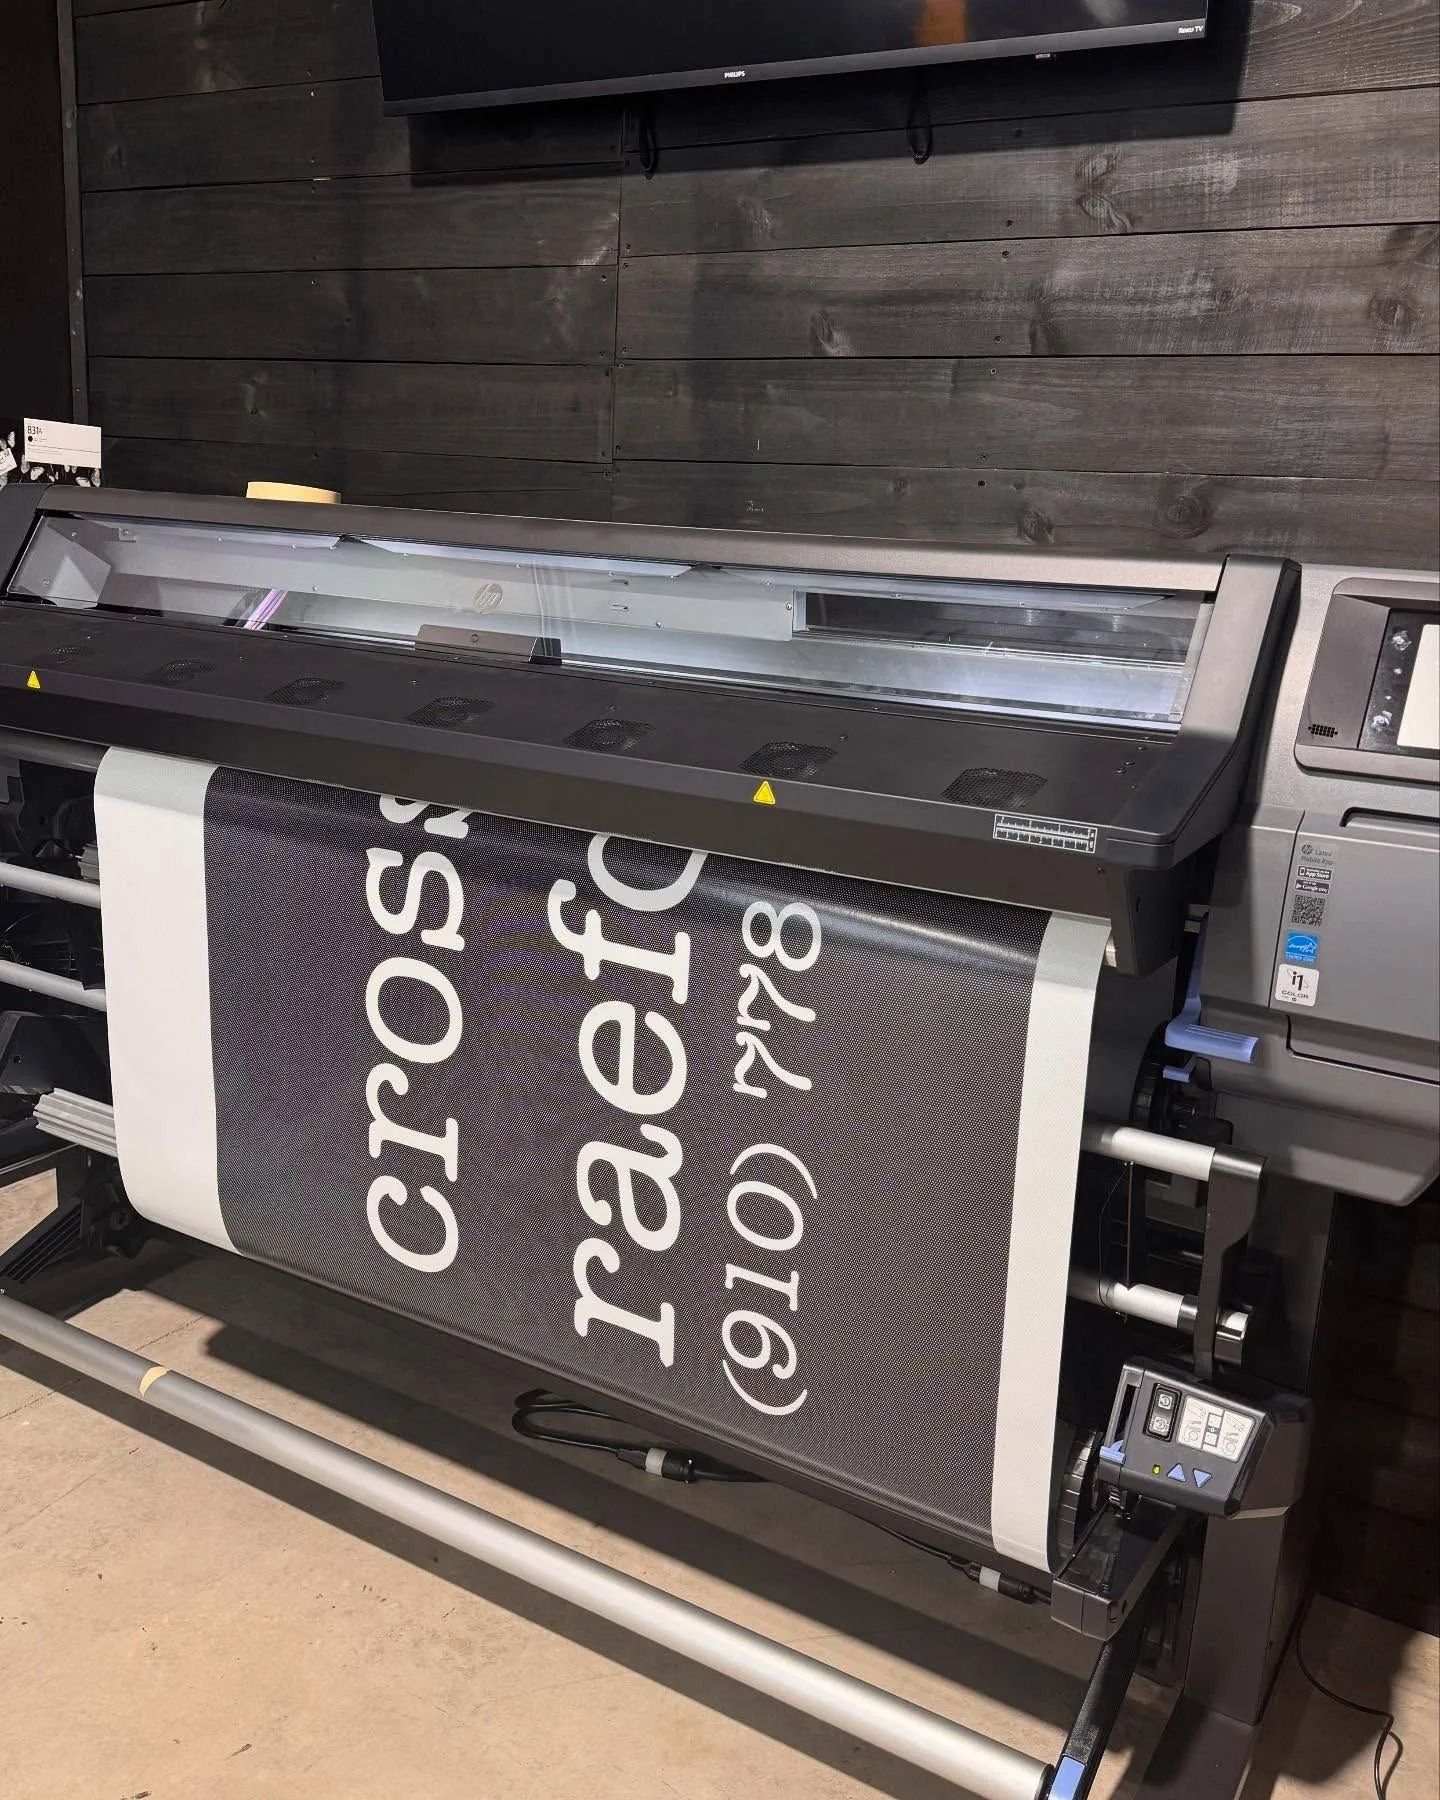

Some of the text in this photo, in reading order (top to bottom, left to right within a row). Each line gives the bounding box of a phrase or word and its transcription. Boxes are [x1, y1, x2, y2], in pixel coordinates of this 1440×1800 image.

[724, 70, 746, 78] PHILIPS
[1281, 990, 1309, 999] COLOR
[722, 900, 822, 1416] (910) 778
